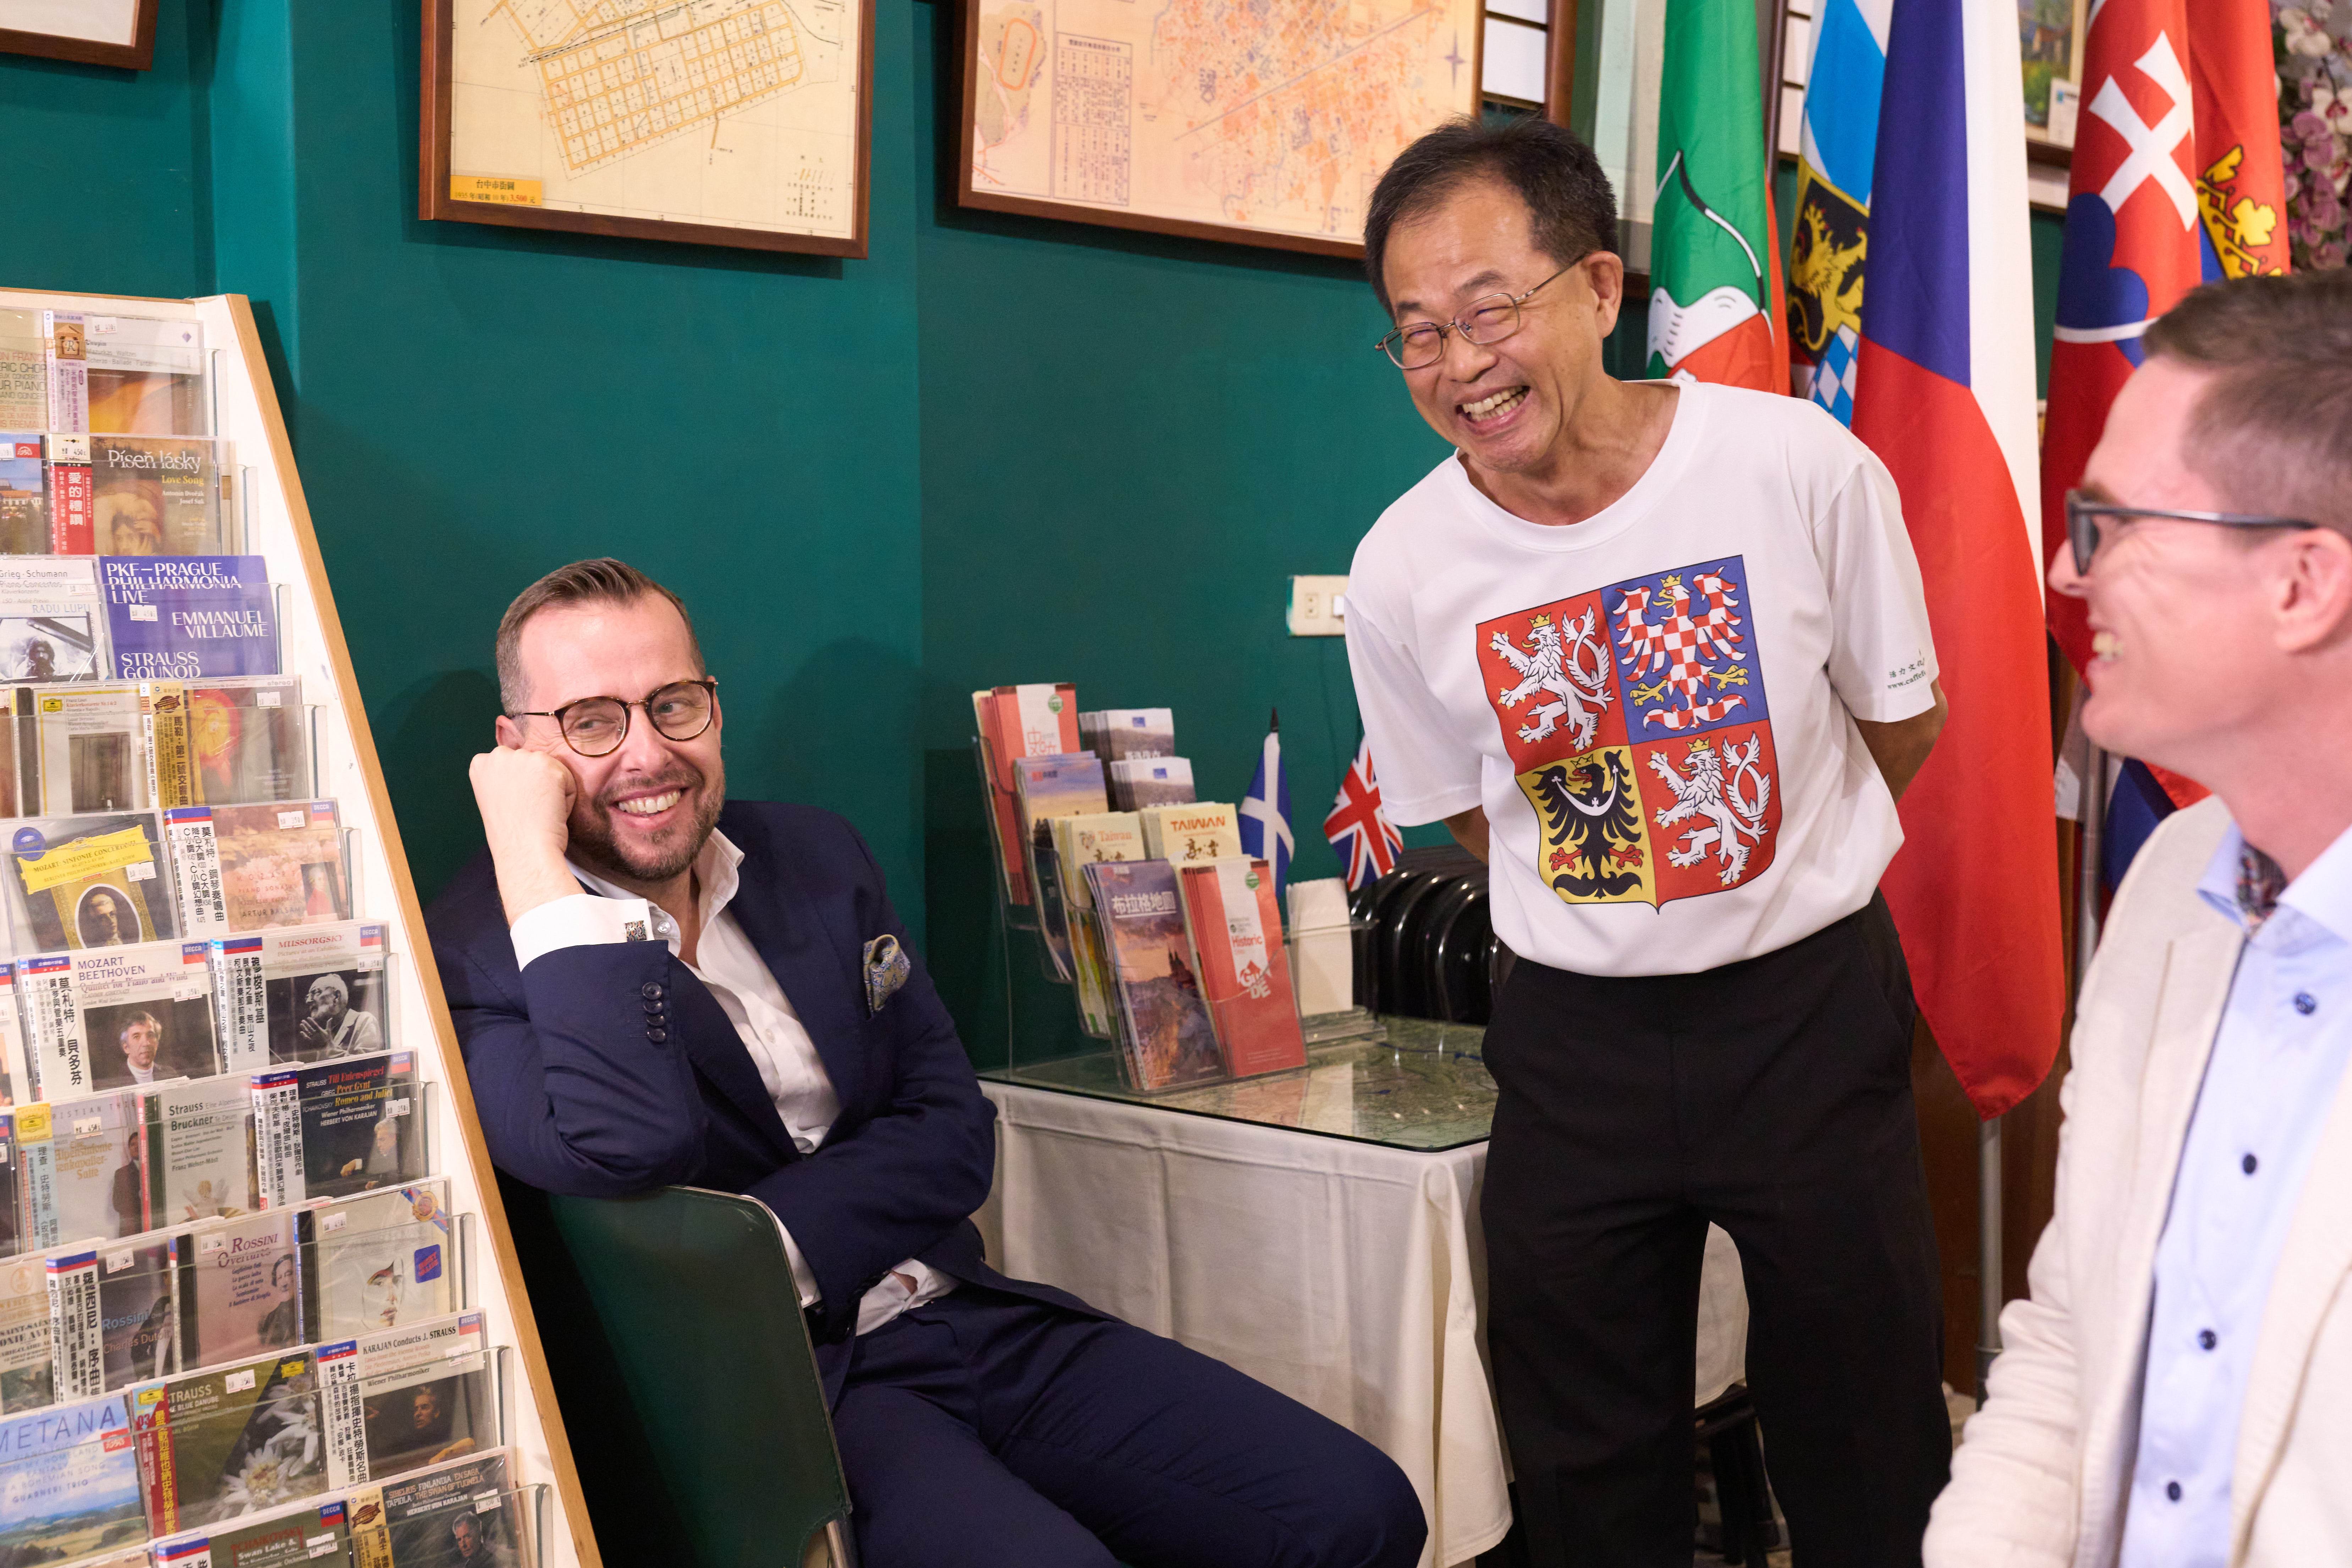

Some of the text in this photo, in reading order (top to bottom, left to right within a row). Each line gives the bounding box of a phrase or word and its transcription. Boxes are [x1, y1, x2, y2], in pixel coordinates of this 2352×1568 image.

[108, 450, 201, 474] Píseň lásky
[161, 475, 204, 487] Love Song
[108, 576, 242, 590] PHILHARMONIA
[112, 590, 149, 604] LIVE
[32, 605, 59, 613] RADU
[172, 611, 268, 625] EMMANUEL
[185, 623, 270, 638] VILLAUME
[121, 651, 199, 667] STRAUSS
[123, 665, 201, 680] GOUNOD
[1889, 658, 1925, 678] 活力文化
[1170, 816, 1226, 832] TAIWAN
[1098, 830, 1132, 842] Taiwan
[63, 853, 93, 865] SINFONIE
[1111, 891, 1176, 915] 布拉格地圖
[242, 909, 268, 918] ARTUR
[278, 934, 345, 948] MUSSORGSKY
[1232, 934, 1263, 947] Historic
[78, 957, 124, 970] MOZART
[79, 965, 145, 981] BEETHOVEN
[306, 1079, 327, 1089] STRAUSS
[341, 1065, 385, 1083] Eulenspiegel
[337, 1084, 352, 1095] Peer
[354, 1080, 371, 1091] Gynt
[335, 1096, 359, 1107] Romeo
[359, 1092, 373, 1102] and
[374, 1088, 393, 1099] Juliet
[169, 1102, 203, 1116] Strauss
[339, 1104, 376, 1115] Philharmoniker
[171, 1115, 213, 1131] Bruckner
[320, 1118, 340, 1127] HERBERT
[355, 1110, 377, 1121] KARAJAN
[102, 1309, 150, 1330] Rossini
[461, 1315, 477, 1324] DECCA
[363, 1340, 392, 1355] KARAJAN
[394, 1336, 421, 1348] Conducts
[430, 1326, 456, 1339] STRAUSS
[388, 1368, 430, 1382] Philharmoniker
[169, 1385, 212, 1403] TRAUSS
[178, 1396, 219, 1411] BLUE DANUBE
[418, 1476, 452, 1491] FINLANDIA
[385, 1495, 413, 1508] TAPIOLA
[415, 1491, 426, 1500] THE
[428, 1487, 446, 1497] SWAN
[407, 1506, 431, 1516] HERBERT
[443, 1494, 468, 1507] KARAJAN
[322, 1505, 340, 1515] DECCA
[238, 1548, 262, 1560] Swan
[265, 1542, 285, 1553] Lake
